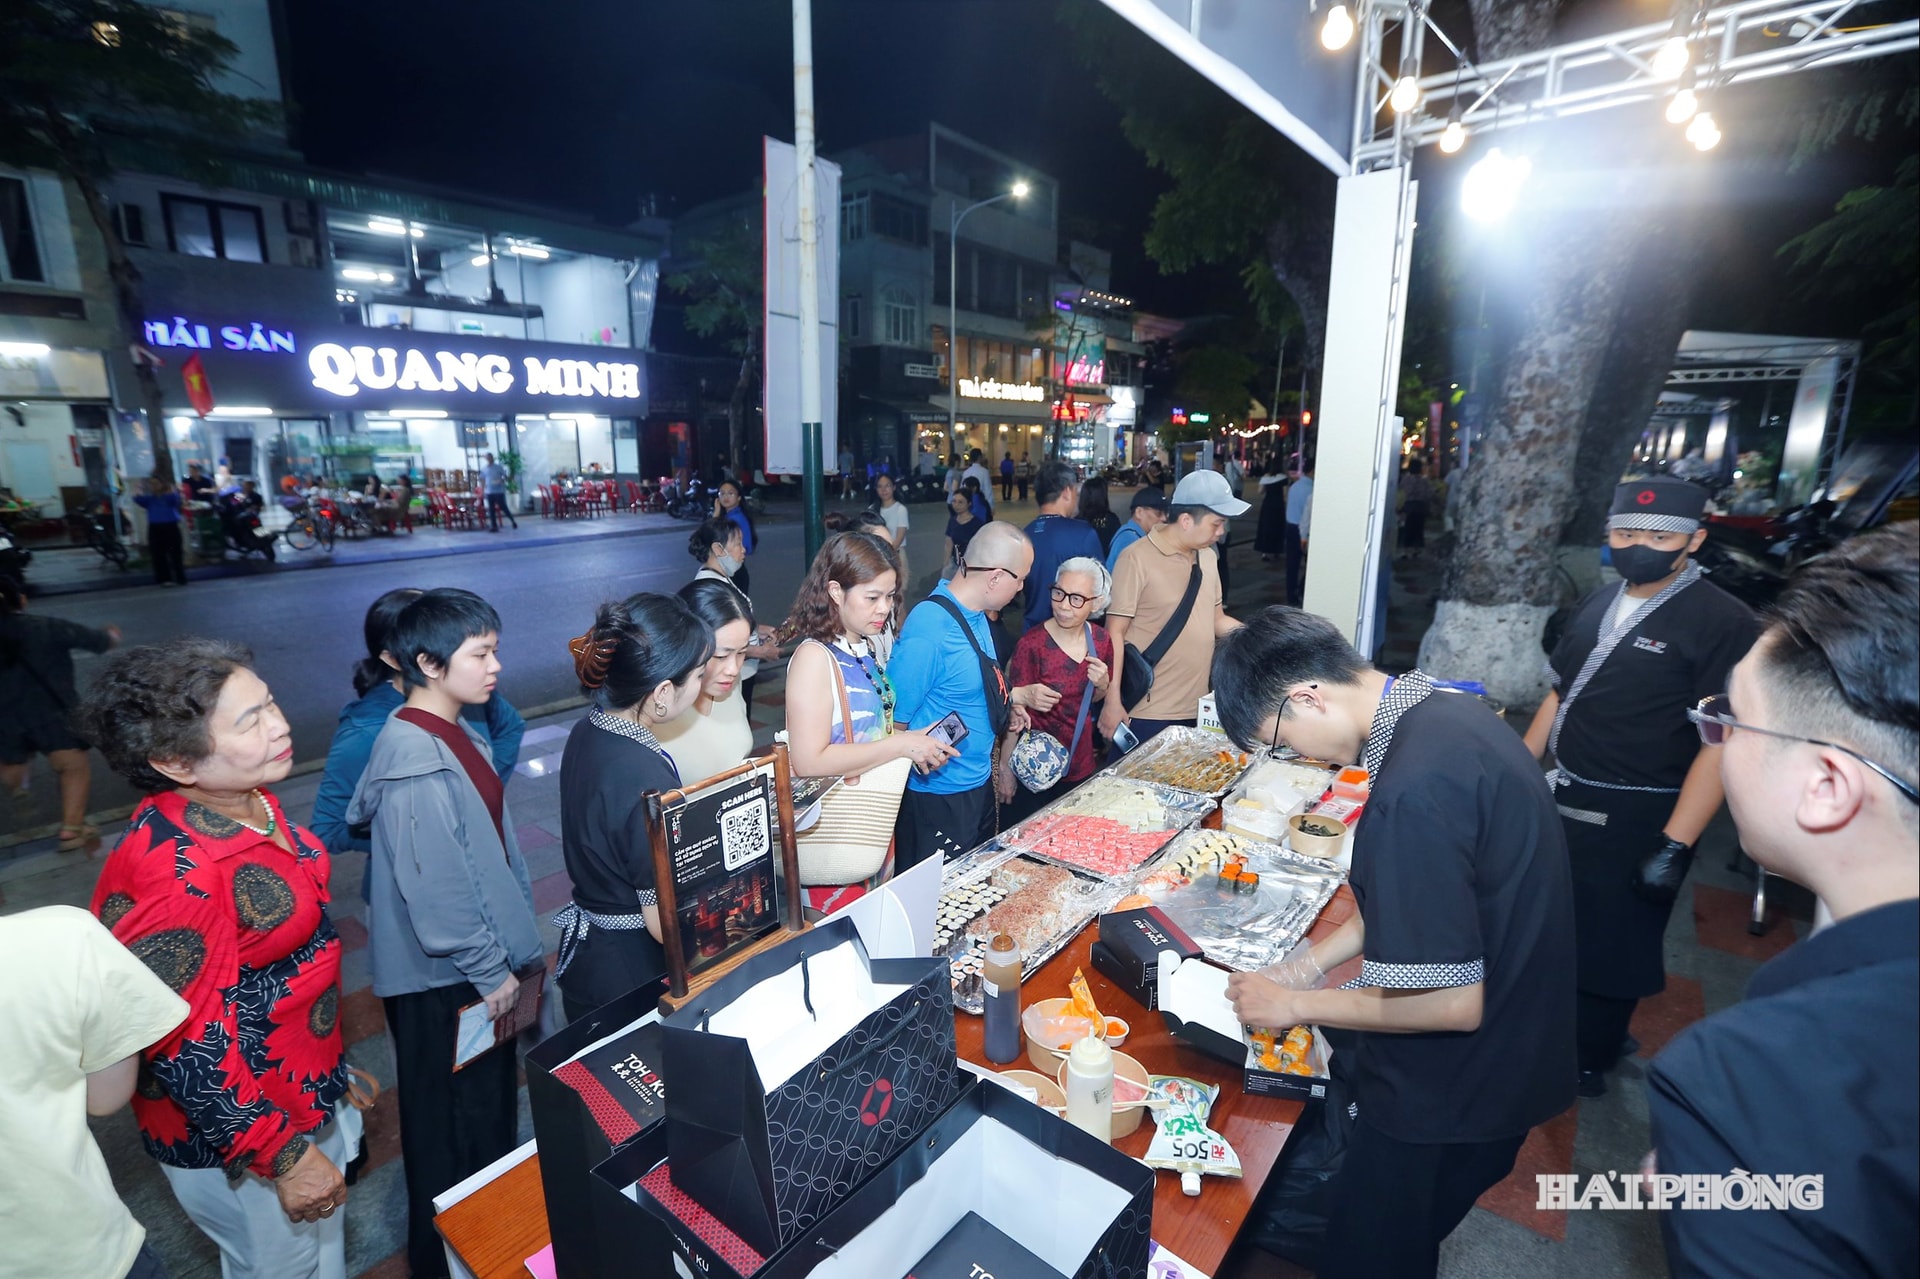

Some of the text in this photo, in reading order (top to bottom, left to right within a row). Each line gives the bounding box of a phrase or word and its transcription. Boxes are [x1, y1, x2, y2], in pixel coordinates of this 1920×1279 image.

[144, 316, 296, 353] HẢI SẢN
[309, 343, 640, 398] QUANG MINH
[721, 786, 763, 810] SCAN HERE
[675, 848, 684, 857] CẢM
[1133, 919, 1162, 946] TOHOKU
[624, 1053, 665, 1099] TOHOKU
[631, 1076, 652, 1096] JAPANESE
[626, 1078, 654, 1106] RESTAURANT
[1173, 1138, 1208, 1160] 505
